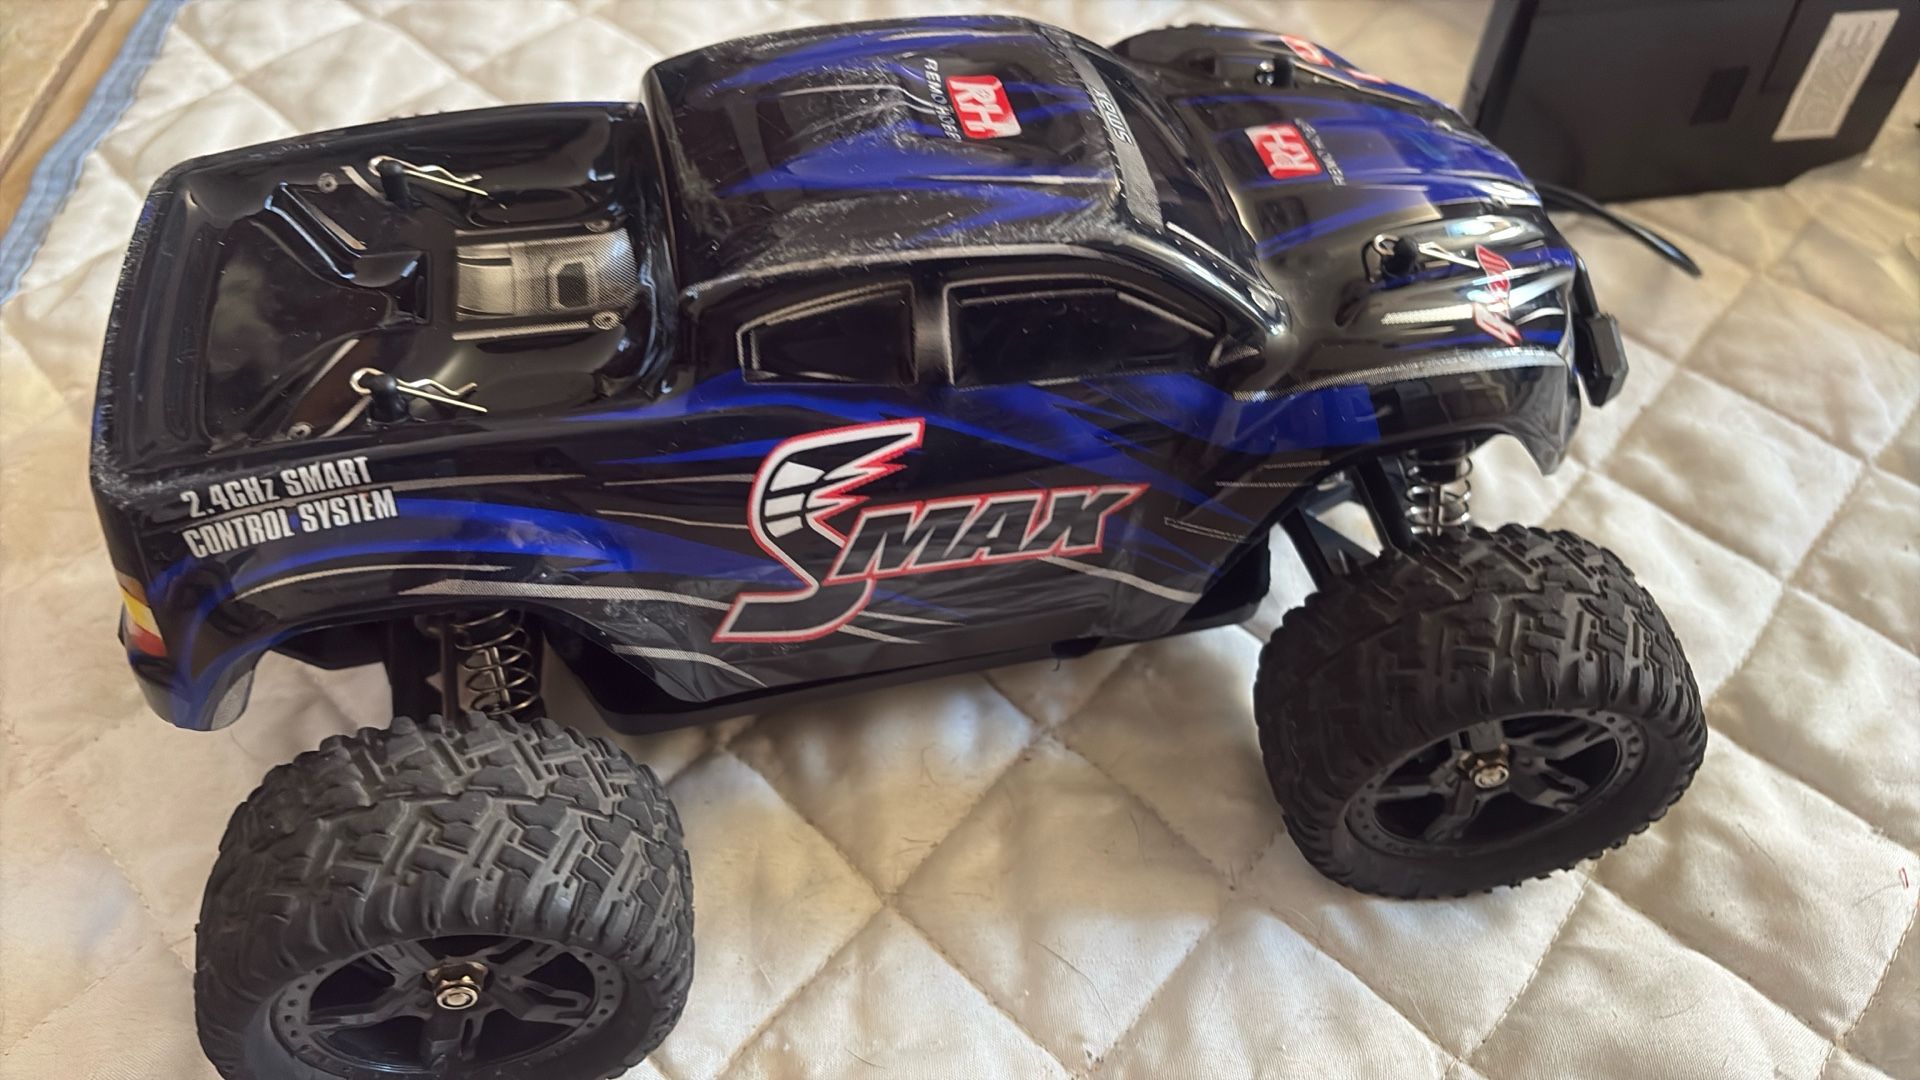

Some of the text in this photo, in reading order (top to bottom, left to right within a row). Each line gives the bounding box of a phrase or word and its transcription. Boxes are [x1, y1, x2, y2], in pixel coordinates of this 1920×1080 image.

[924, 58, 948, 105] REMO
[181, 456, 373, 518] 2.4GHz SMART
[182, 488, 398, 558] CONTROL SYSTEM
